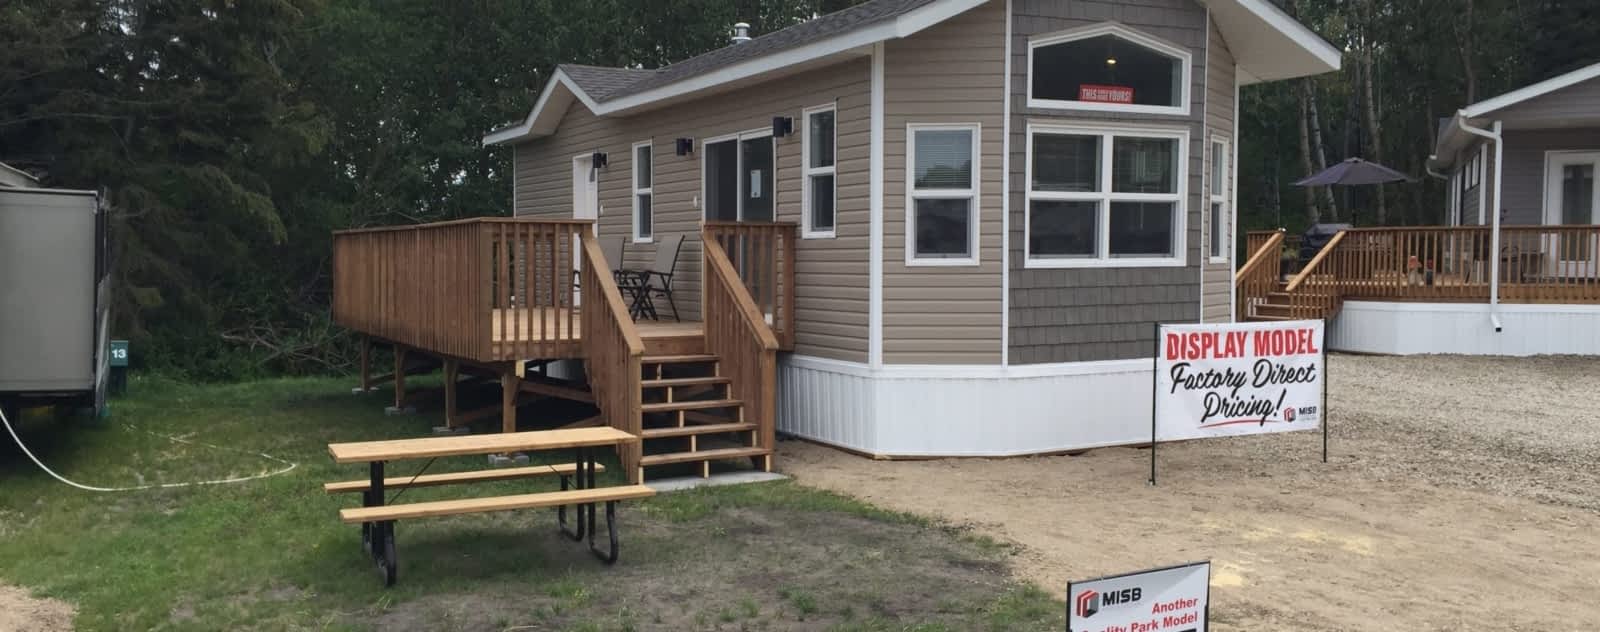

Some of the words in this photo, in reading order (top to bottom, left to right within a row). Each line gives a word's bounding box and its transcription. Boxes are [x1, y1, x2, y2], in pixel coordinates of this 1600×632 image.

[112, 349, 126, 358] 13
[1166, 331, 1248, 360] DISPLAY
[1254, 328, 1318, 357] MODEL
[1170, 362, 1247, 398] Factory
[1252, 359, 1316, 388] Direct
[1200, 388, 1287, 427] Pricing!
[1102, 588, 1142, 606] MISB
[1152, 598, 1198, 614] Another
[1131, 620, 1159, 632] Park
[1163, 611, 1198, 628] Model
